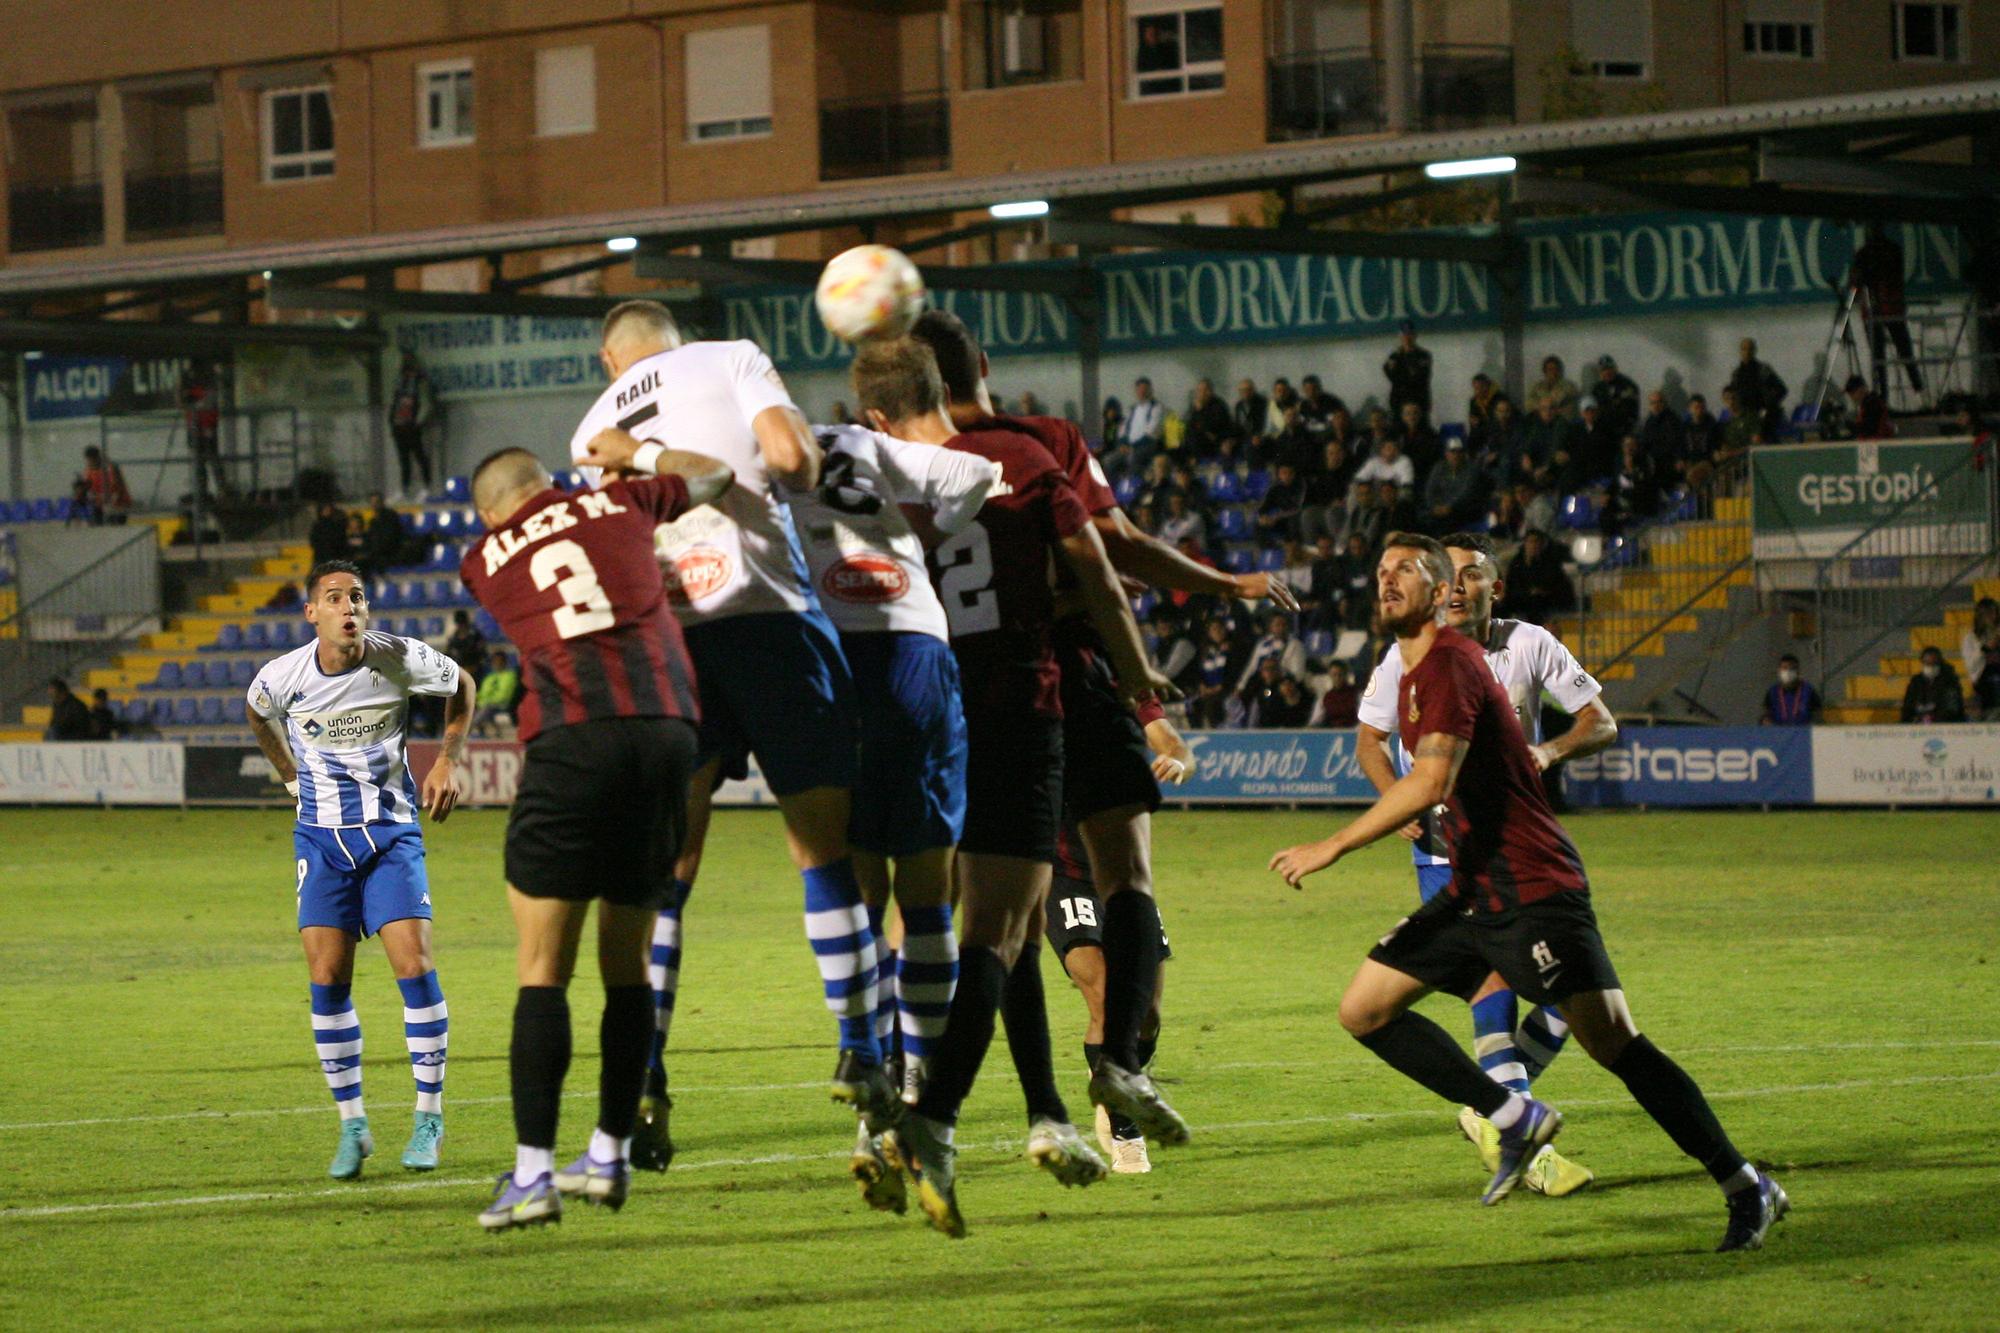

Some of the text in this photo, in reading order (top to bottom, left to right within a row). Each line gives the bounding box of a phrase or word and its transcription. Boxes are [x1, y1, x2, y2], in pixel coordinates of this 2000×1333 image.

[34, 364, 111, 403] ALCOI
[615, 370, 664, 411] RAÚL
[529, 538, 616, 640] 3
[936, 520, 1001, 638] 2
[327, 713, 363, 726] unión
[328, 720, 386, 741] alcoyano
[1241, 781, 1338, 794] ROPA HOMBRE
[1059, 896, 1098, 930] 15
